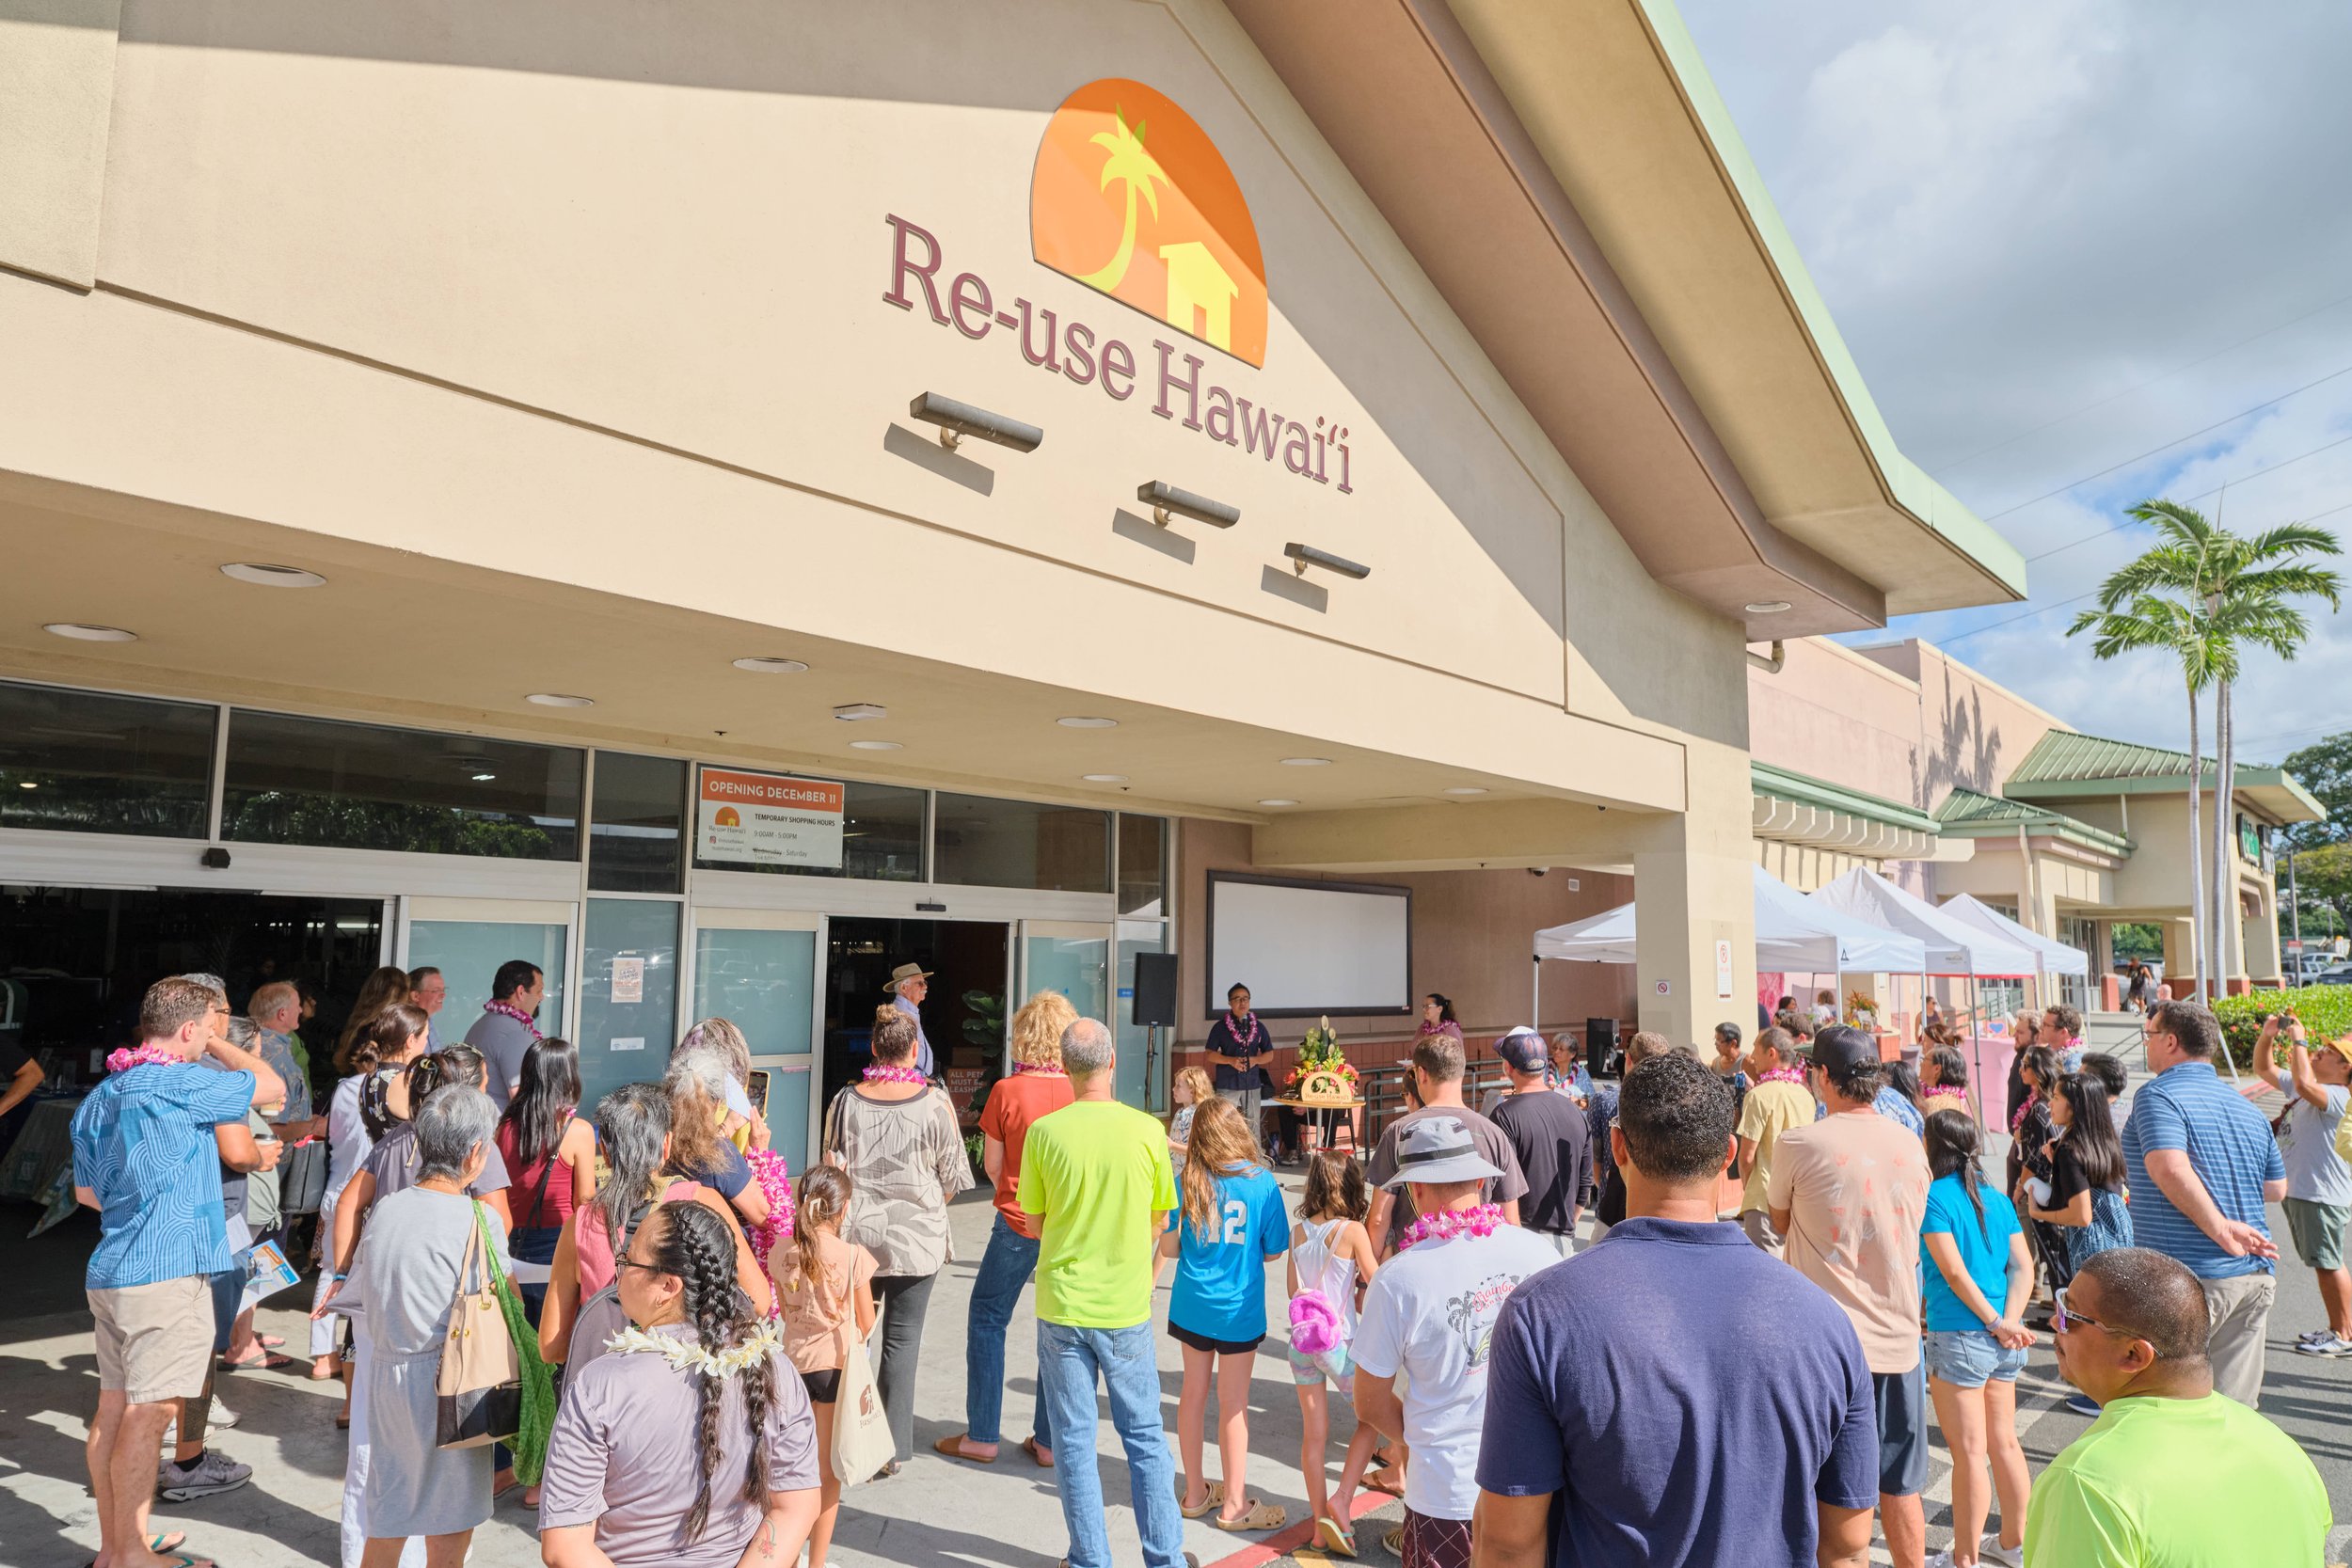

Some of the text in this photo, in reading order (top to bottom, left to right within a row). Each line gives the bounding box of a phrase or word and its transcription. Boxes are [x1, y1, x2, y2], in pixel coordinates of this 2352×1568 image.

[882, 213, 1136, 400] Re-use
[709, 781, 836, 804] OPENING DECEMBER 11
[755, 813, 787, 823] TEMPORARY
[788, 816, 816, 825] SHOPPING
[754, 830, 774, 838] 9:00AM
[778, 832, 798, 840] 5:00PM
[786, 848, 807, 858] Saturday
[1472, 1280, 1518, 1313] Rainbo
